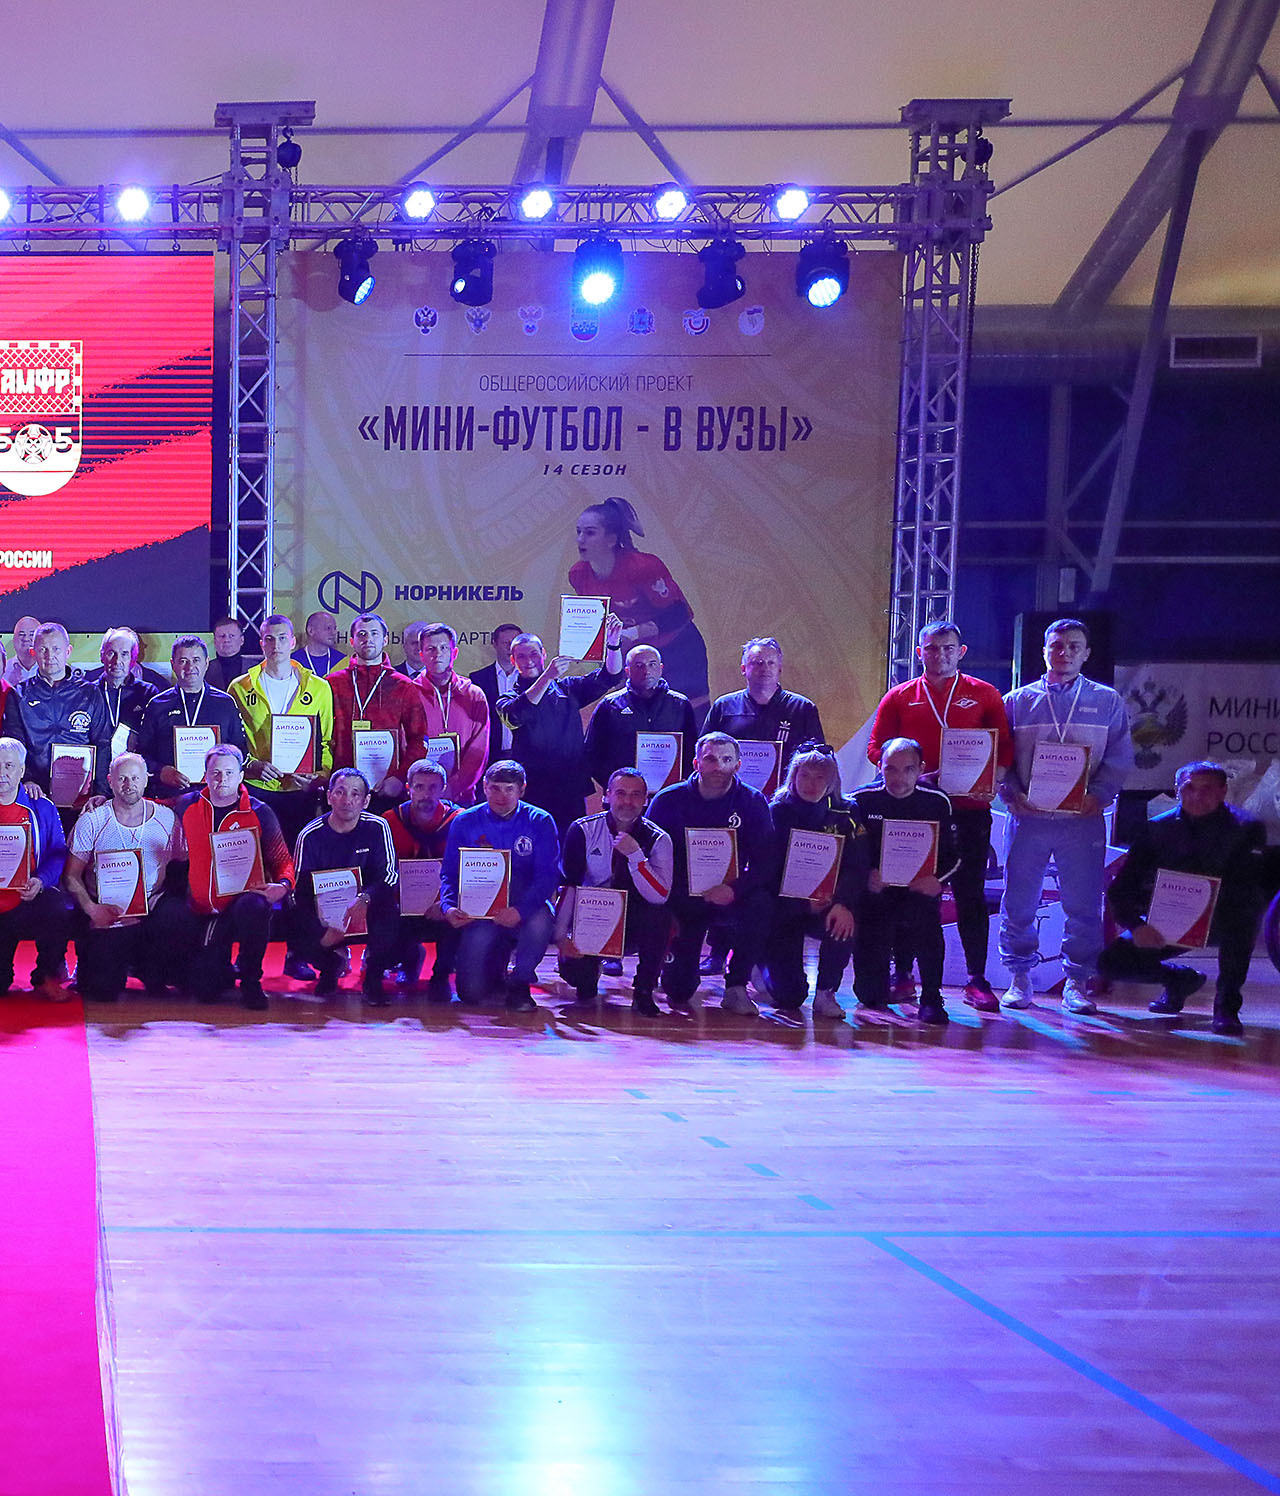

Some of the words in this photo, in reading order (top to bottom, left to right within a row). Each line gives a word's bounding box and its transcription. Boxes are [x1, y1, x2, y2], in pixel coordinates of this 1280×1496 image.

[0, 367, 71, 394] АМФР
[479, 373, 631, 393] ОБЩЕРОССИЙСКИЙ
[636, 375, 694, 392] ПРОЕКТ
[664, 406, 682, 451] В
[543, 464, 564, 476] 14
[570, 464, 627, 476] СЕЗОН
[395, 584, 524, 601] НОРНИКЕЛЬ
[1039, 753, 1077, 761] ДИПЛОМ
[888, 830, 925, 838] ДИПЛОМ
[217, 839, 248, 849] ДИПЛОМ
[794, 841, 830, 851] ДИПЛОМ
[101, 861, 132, 869] ДИПЛОМ
[318, 880, 350, 889] ДИПЛОМ
[1161, 883, 1203, 894] ДИПЛОМ
